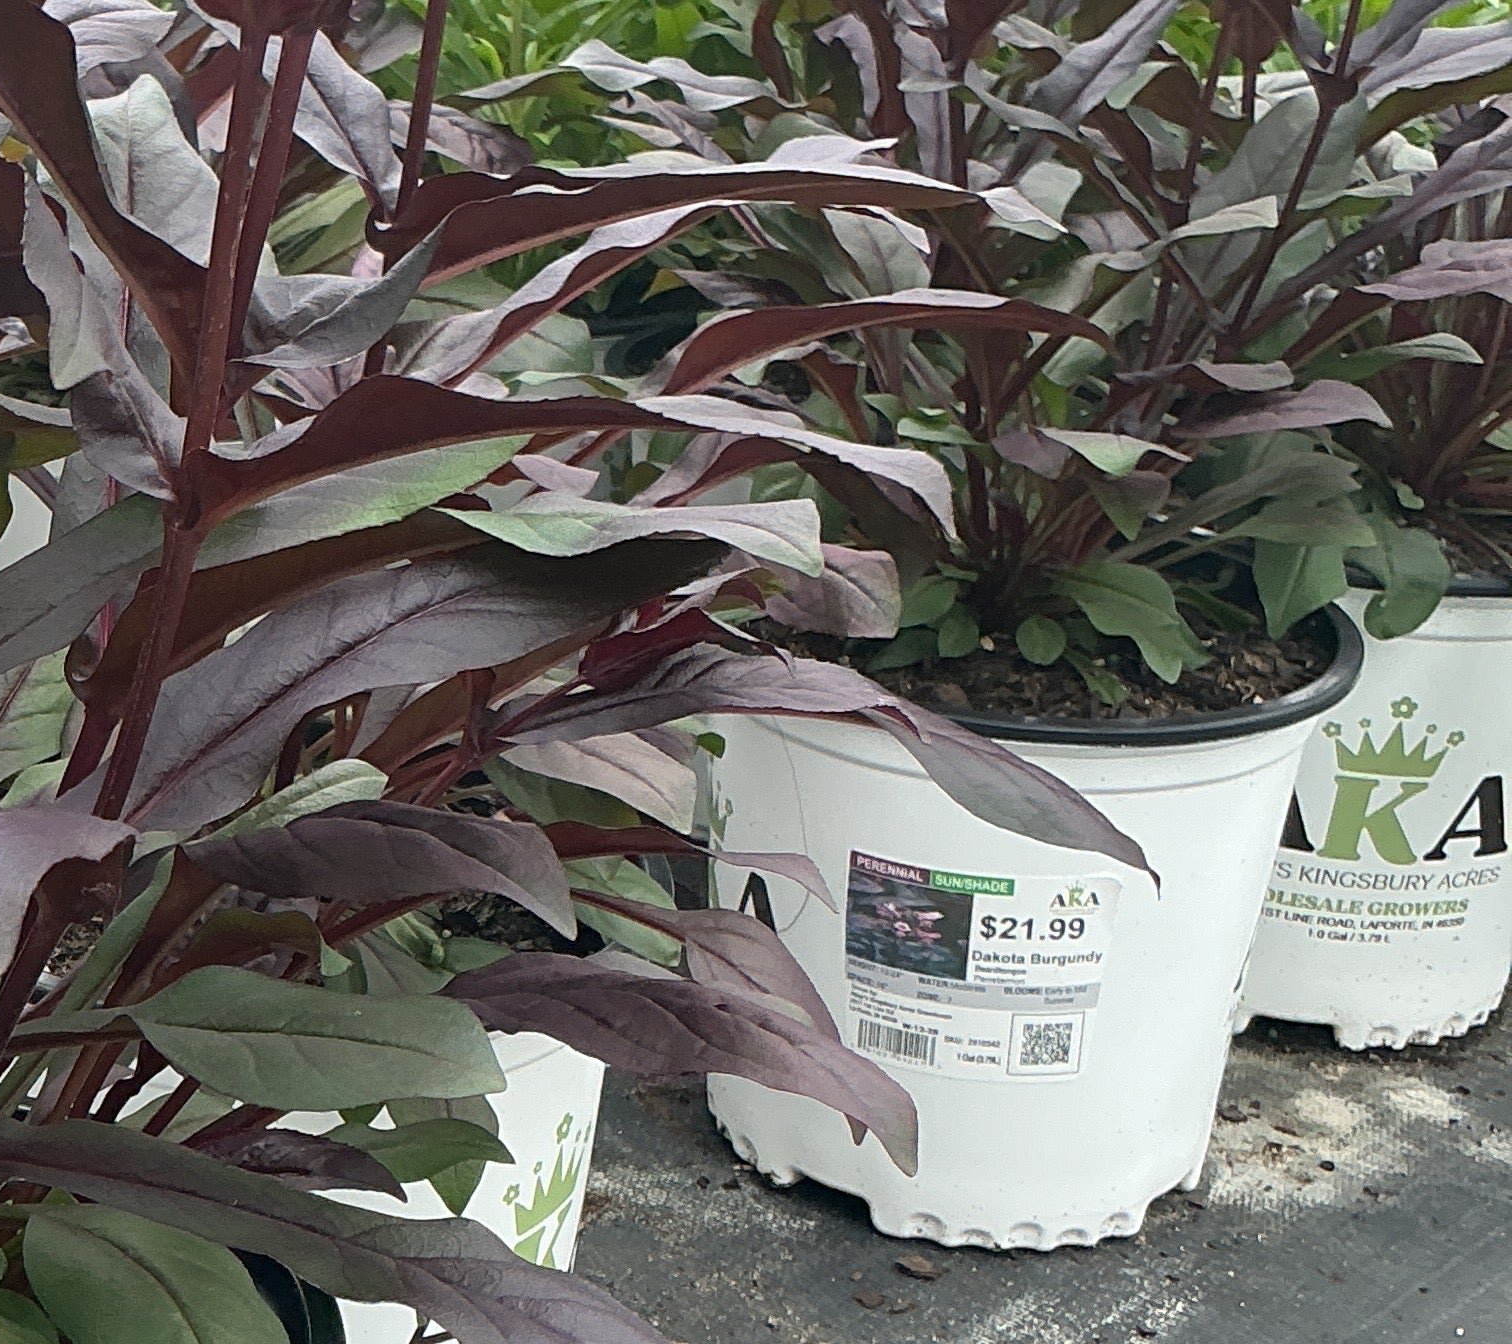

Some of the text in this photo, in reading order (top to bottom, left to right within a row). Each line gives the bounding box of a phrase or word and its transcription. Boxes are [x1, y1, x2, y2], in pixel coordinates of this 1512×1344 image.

[855, 855, 924, 883] PERENNIAL
[1299, 865, 1435, 890] KINGSBURY
[1437, 866, 1502, 890] ACRES
[934, 874, 1009, 893] SUN/SHADE
[1049, 890, 1101, 908] AKA
[1367, 898, 1470, 917] GROWERS
[979, 914, 1086, 941] $21.99
[971, 949, 1103, 967] Dakota Burgundy
